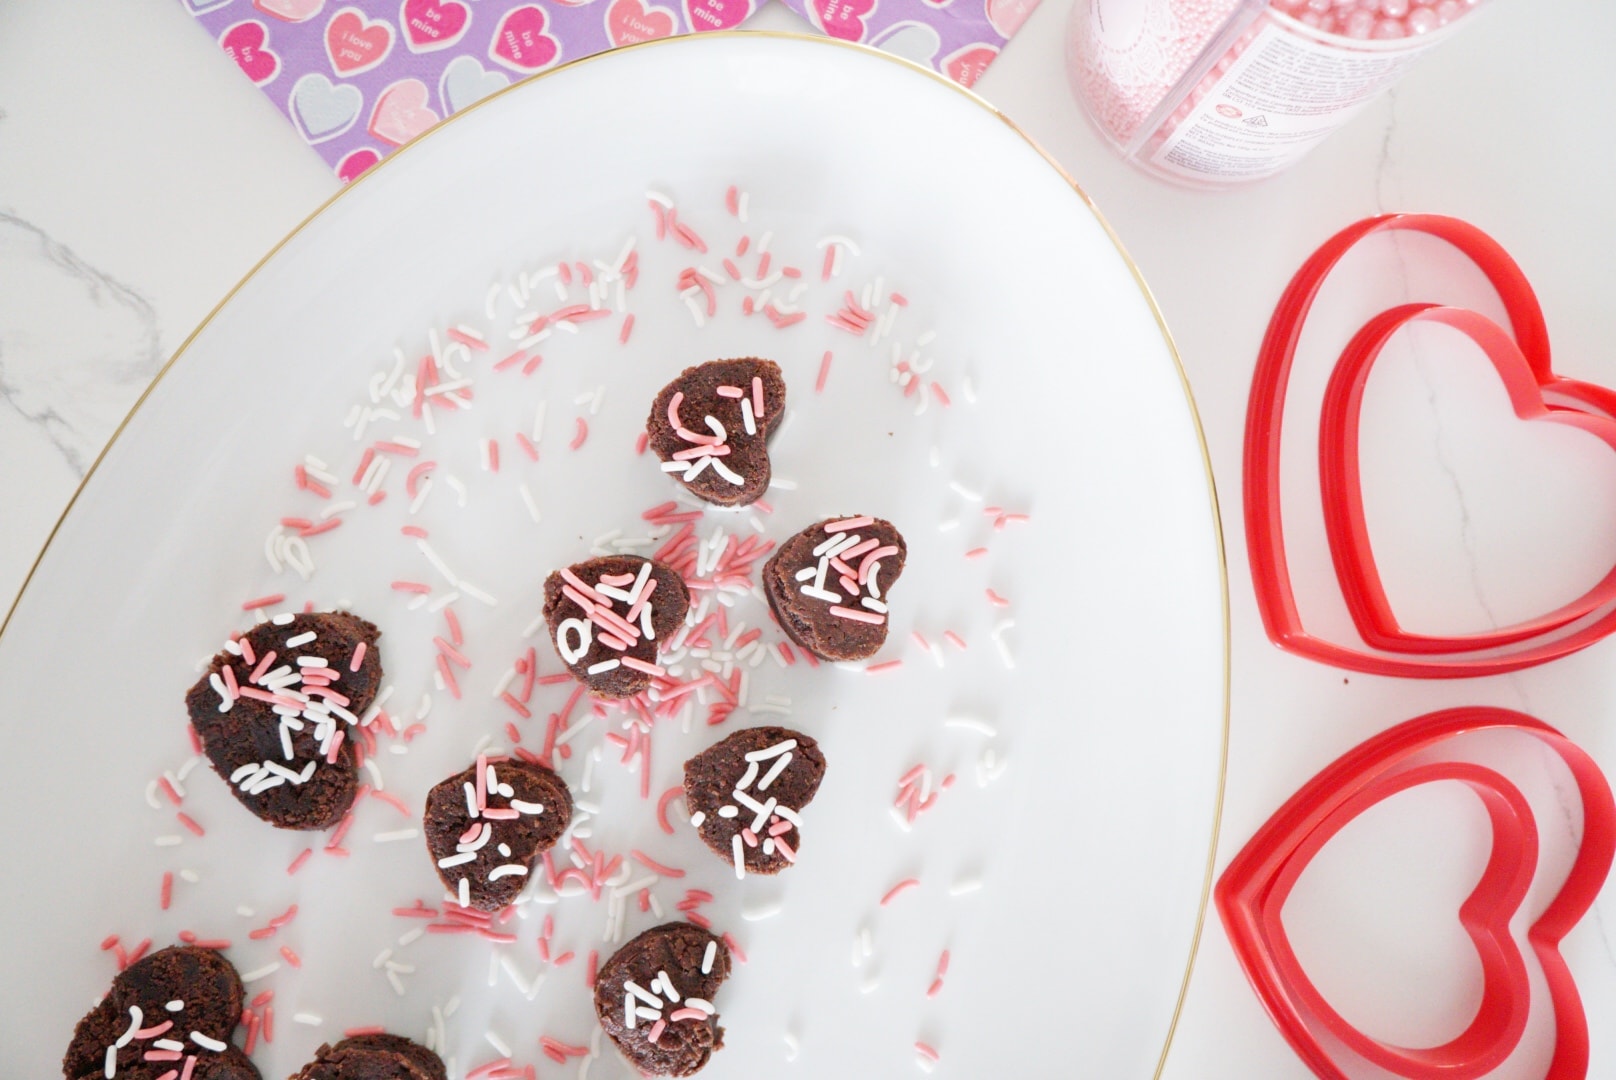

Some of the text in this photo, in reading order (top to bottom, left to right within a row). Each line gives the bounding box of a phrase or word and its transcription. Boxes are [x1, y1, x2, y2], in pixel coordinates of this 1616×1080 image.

[707, 0, 723, 11] be
[840, 5, 853, 20] be
[425, 8, 442, 22] be
[693, 7, 722, 27] mine
[410, 18, 440, 38] mine
[629, 16, 656, 36] love
[349, 33, 374, 50] love
[504, 30, 523, 60] mine
[521, 30, 534, 47] be
[241, 46, 253, 63] be
[338, 47, 363, 62] you
[958, 62, 971, 85] you
